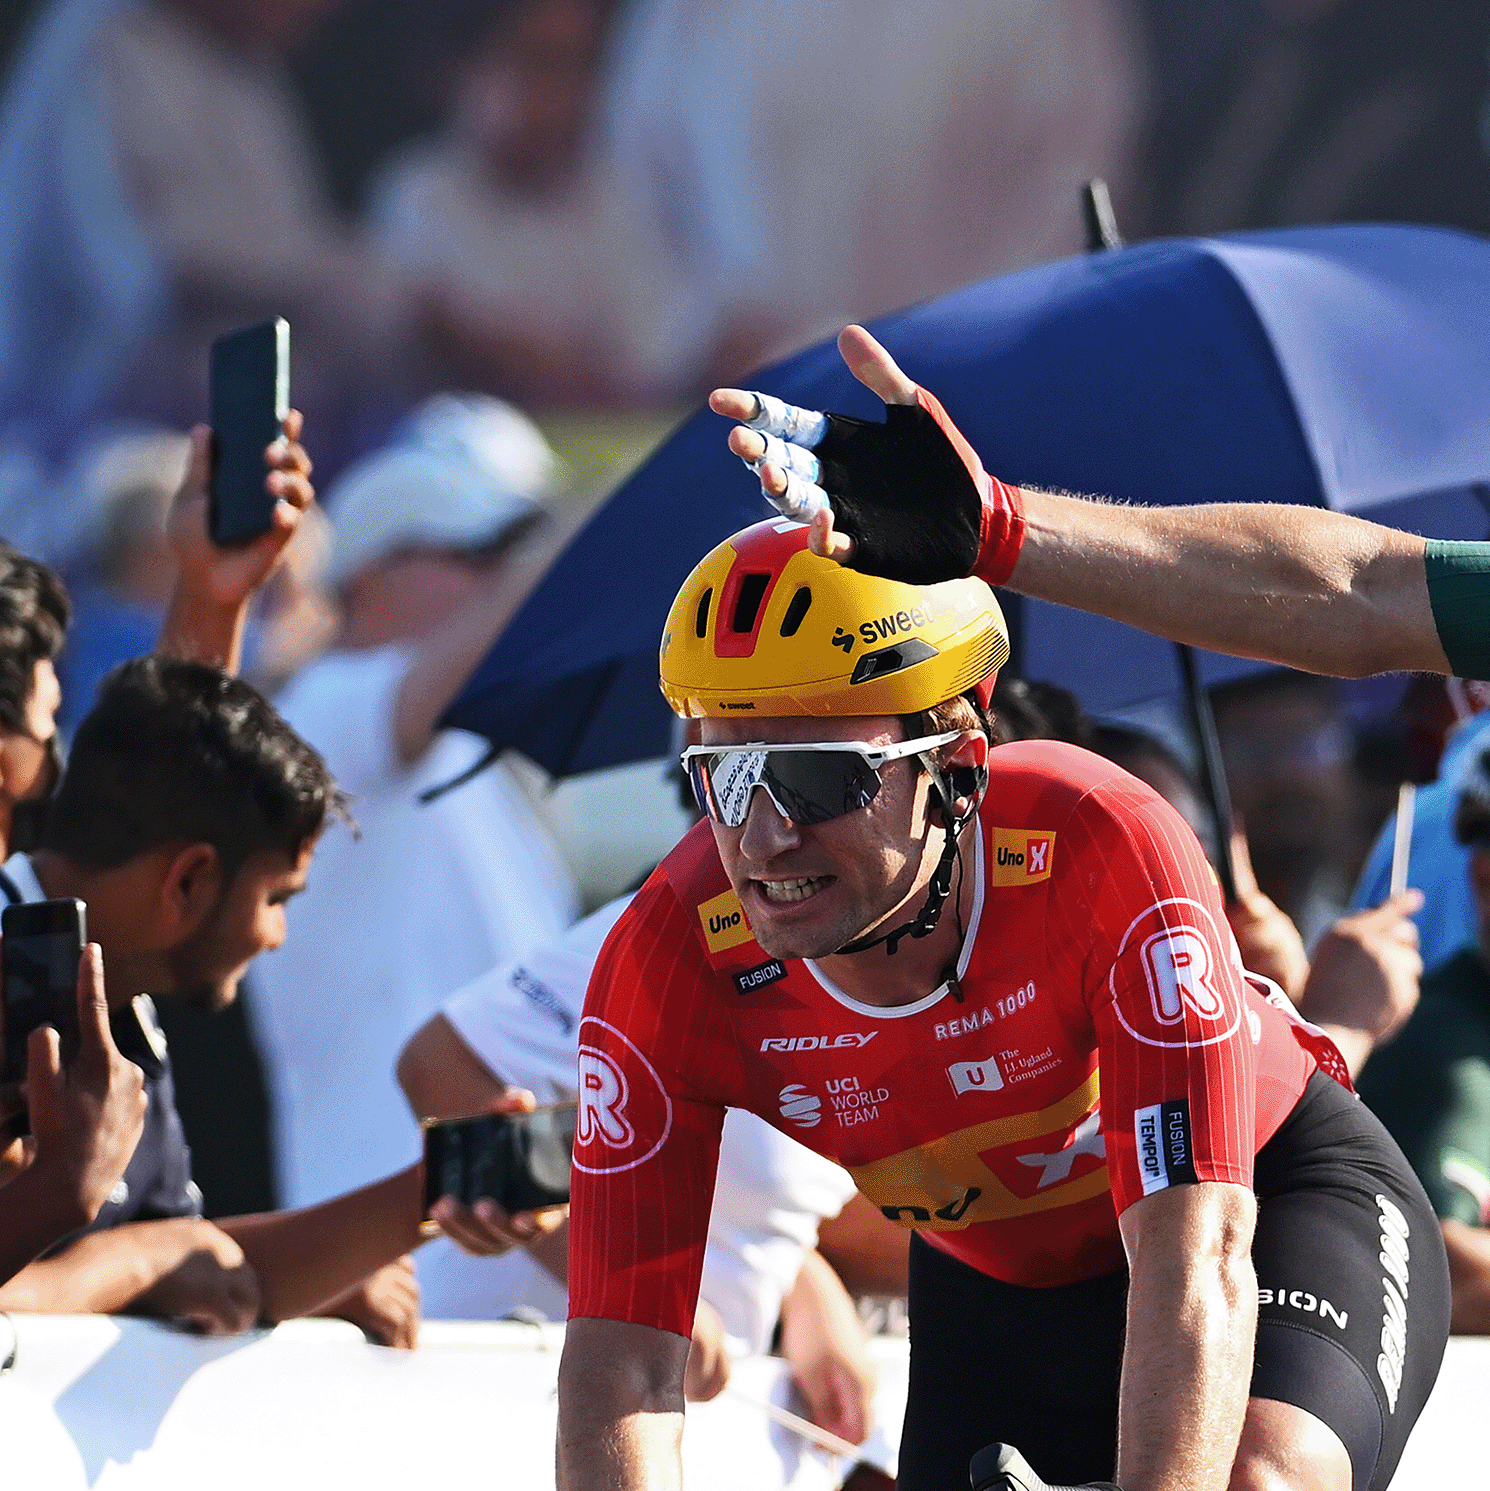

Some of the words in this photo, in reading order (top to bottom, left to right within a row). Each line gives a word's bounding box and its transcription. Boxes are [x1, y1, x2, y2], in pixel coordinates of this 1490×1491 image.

[860, 603, 935, 645] sweet
[727, 701, 757, 710] sweet
[997, 846, 1026, 868] Uno
[709, 911, 741, 935] Uno
[740, 962, 782, 989] FUSION
[934, 1008, 994, 1040] REMA
[998, 981, 1036, 1016] 1000
[760, 1031, 878, 1052] RIDLEY
[999, 1049, 1020, 1060] The
[1019, 1047, 1053, 1067] Ugland
[1009, 1058, 1062, 1083] Companies
[826, 1077, 860, 1094] UCI
[831, 1088, 889, 1111] WORLD
[835, 1106, 880, 1128] TEAM
[1168, 1110, 1186, 1167] FUSION
[1257, 1288, 1349, 1330] SION
